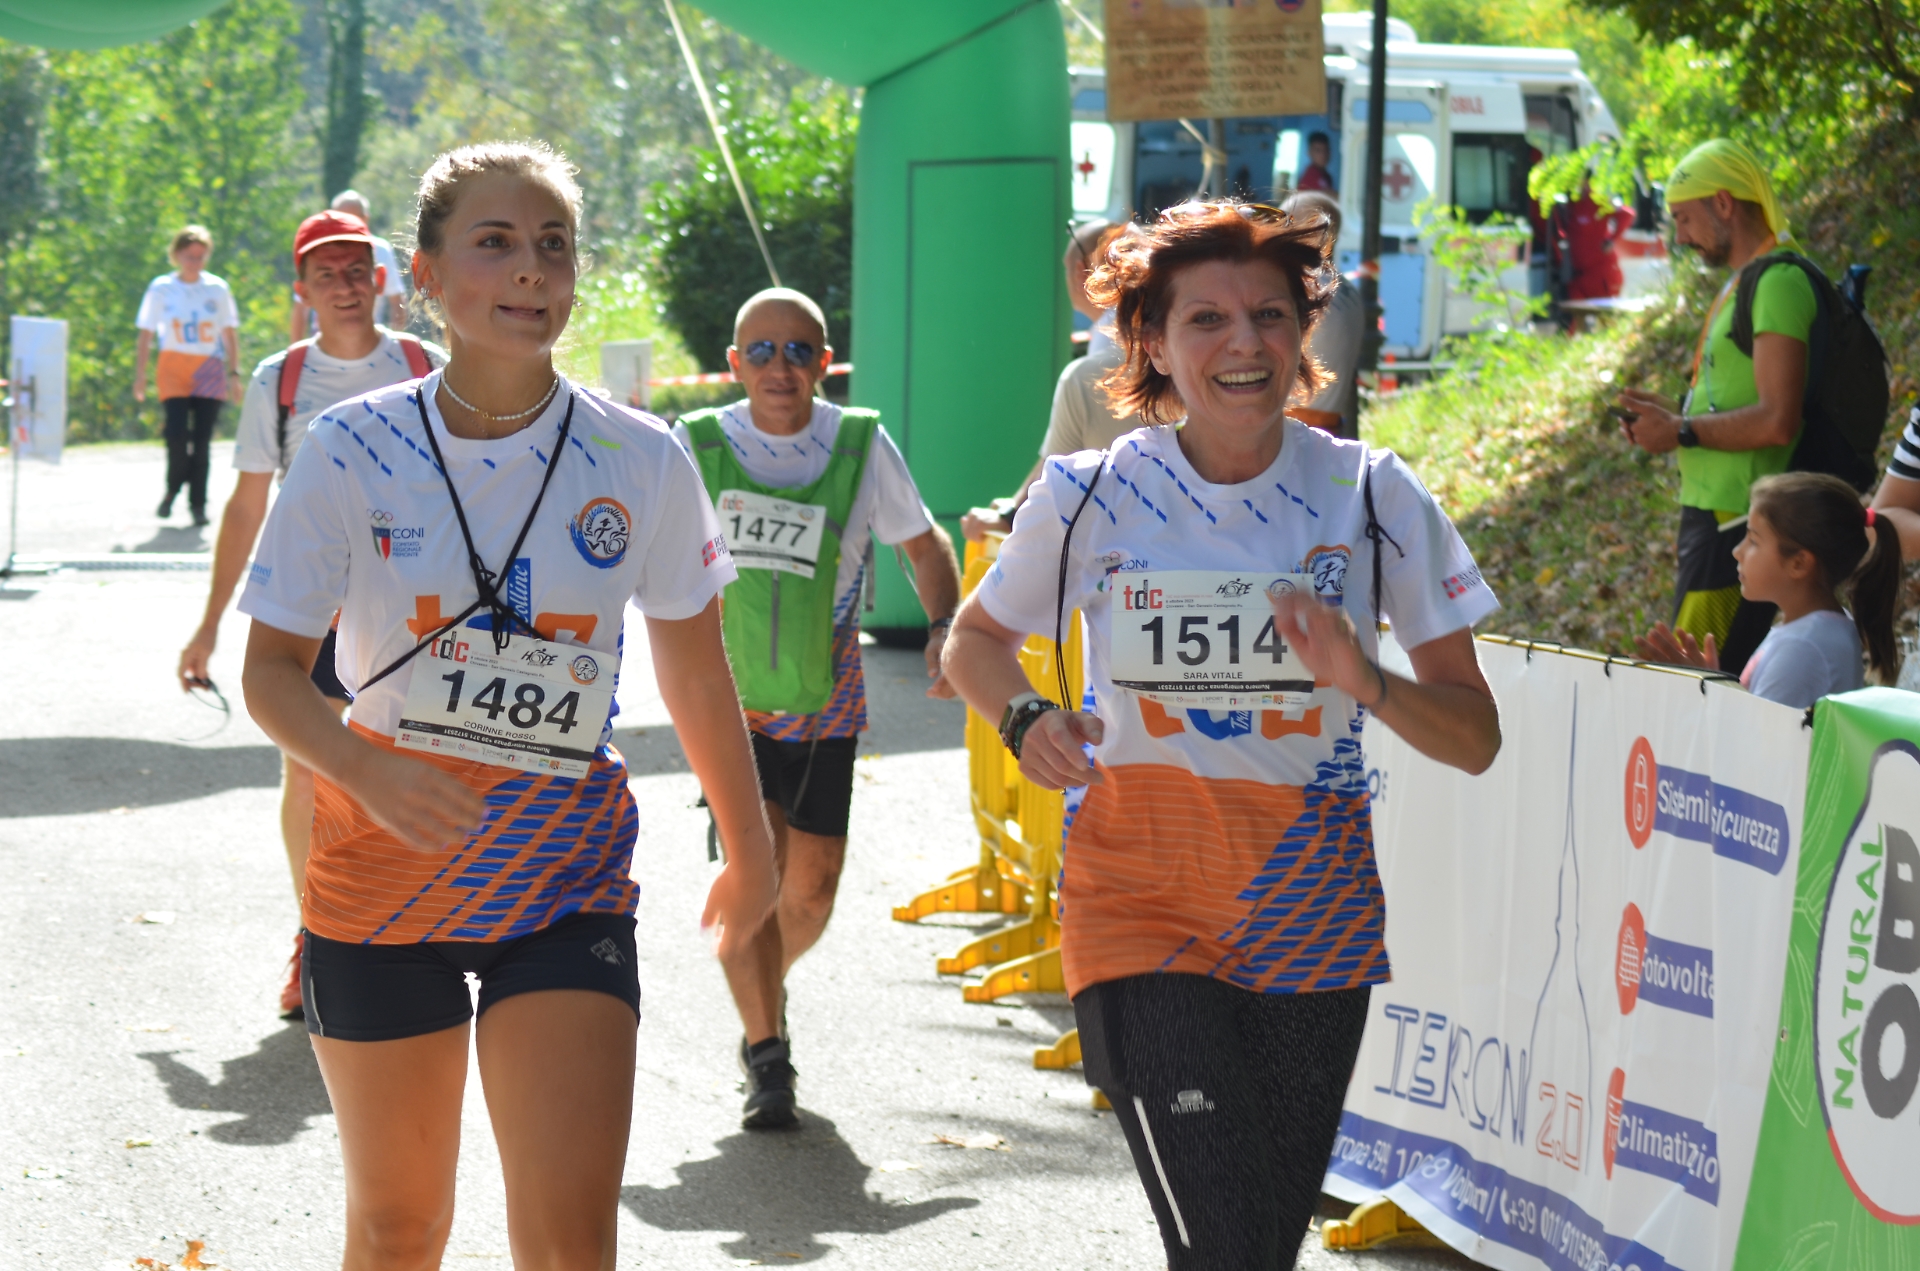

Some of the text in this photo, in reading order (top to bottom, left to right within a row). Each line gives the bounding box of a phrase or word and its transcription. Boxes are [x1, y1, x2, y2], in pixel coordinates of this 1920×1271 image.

[391, 527, 424, 539] CONI
[729, 514, 808, 547] 1477
[1123, 579, 1163, 610] tdc
[430, 631, 470, 663] tdc
[1141, 614, 1288, 666] 1514
[1183, 672, 1243, 680] SARA VITALE
[442, 670, 581, 734] 1484
[463, 720, 536, 741] CORINNE ROSSO
[493, 739, 526, 749] emergenza
[526, 743, 550, 754] Numero
[1657, 779, 1710, 825] Sistemi
[1832, 821, 1884, 1110] NATURAL
[1536, 1081, 1584, 1172] 2.0
[1509, 1197, 1538, 1235] +39
